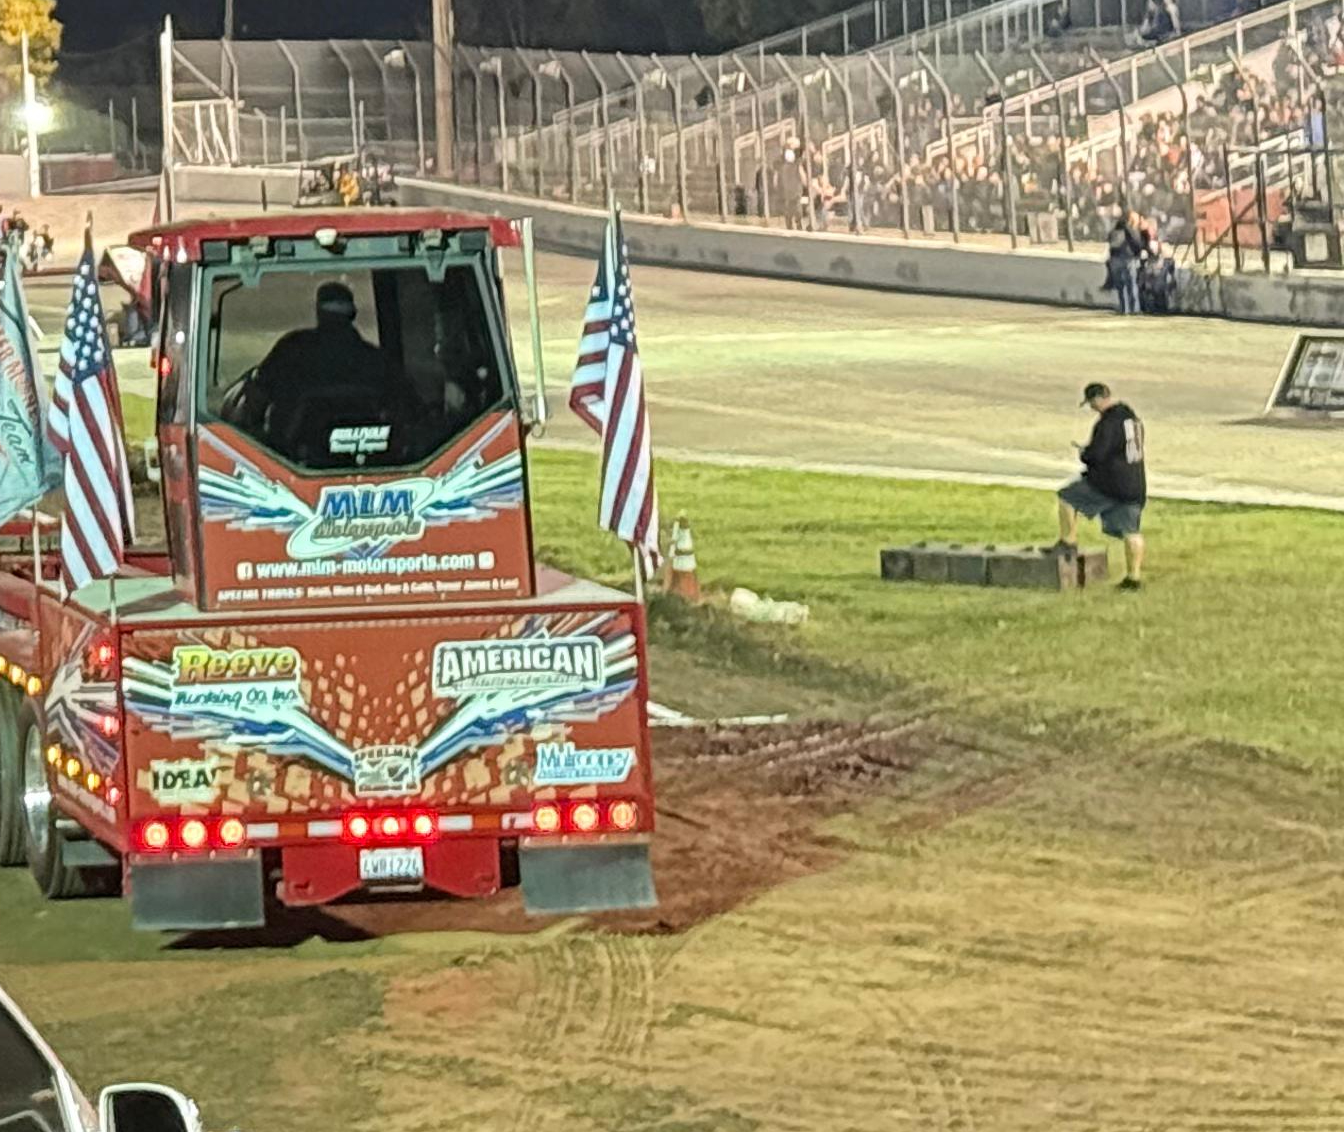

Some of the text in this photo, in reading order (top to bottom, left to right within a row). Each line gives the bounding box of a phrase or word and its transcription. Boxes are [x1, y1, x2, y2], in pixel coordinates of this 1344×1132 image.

[324, 488, 414, 519] MLM
[256, 552, 475, 579] www.mlm-motorsports.com
[177, 649, 295, 683] Reeve
[442, 644, 595, 685] AMERICAN
